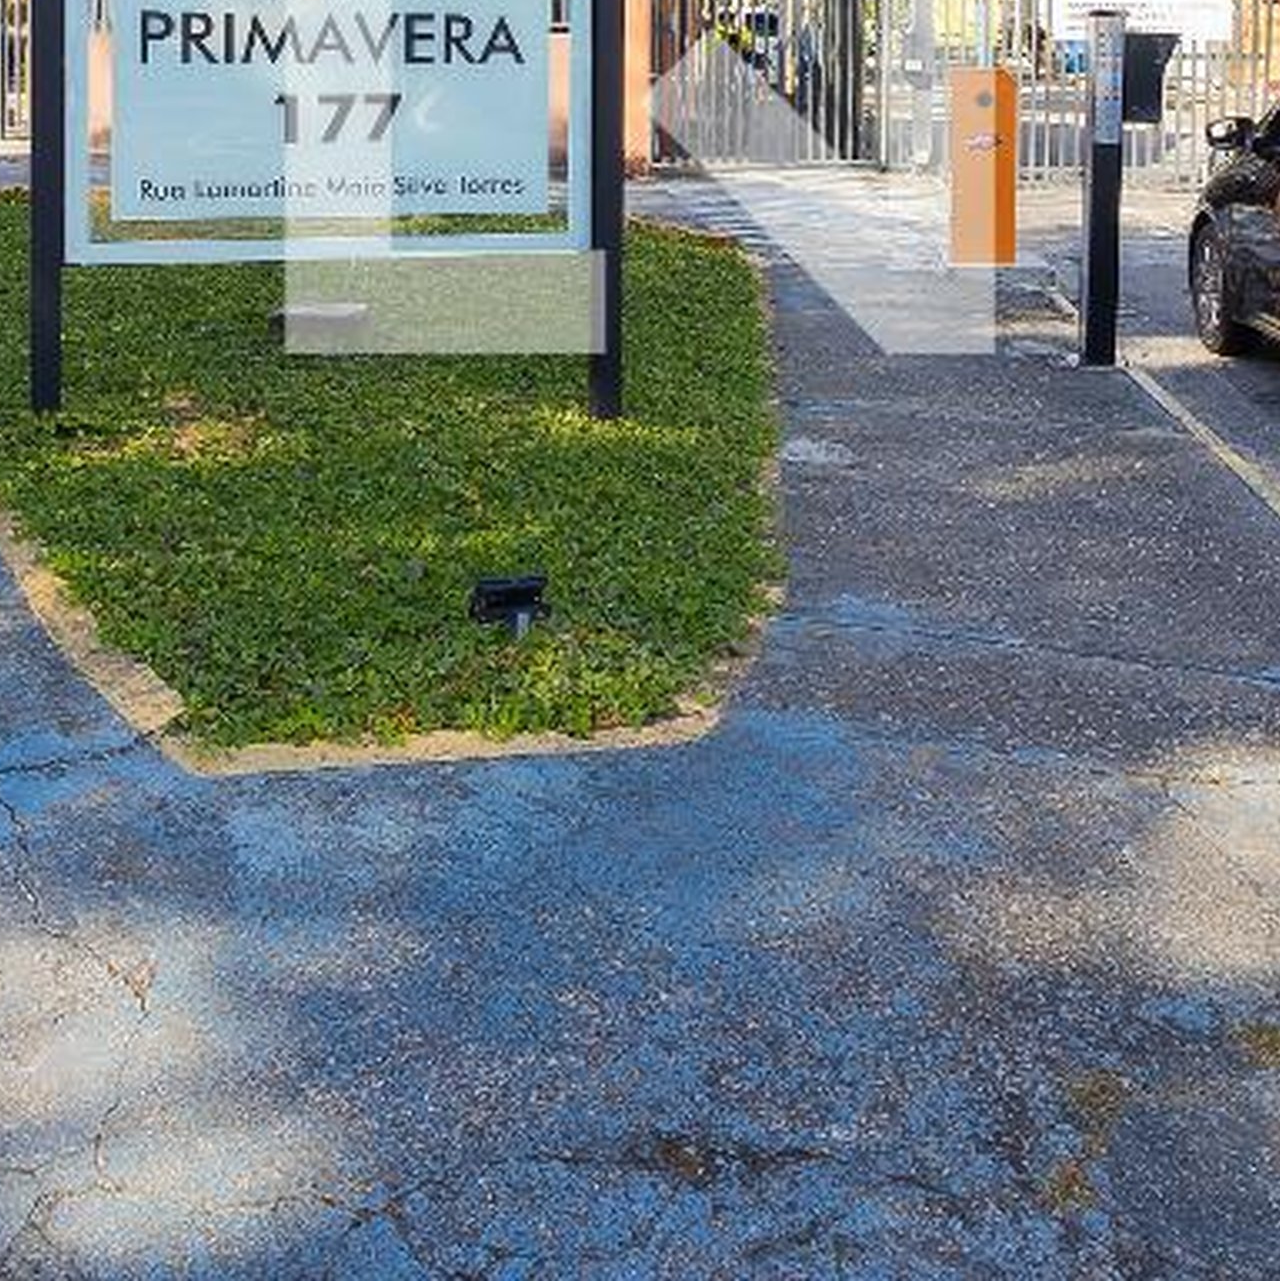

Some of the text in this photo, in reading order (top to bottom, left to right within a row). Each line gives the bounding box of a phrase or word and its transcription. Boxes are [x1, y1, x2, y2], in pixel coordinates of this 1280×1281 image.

[139, 10, 524, 65] PRIMAVERA
[274, 93, 402, 144] 177
[140, 179, 185, 201] Rua
[393, 175, 447, 196] Silva
[456, 175, 525, 196] Torres
